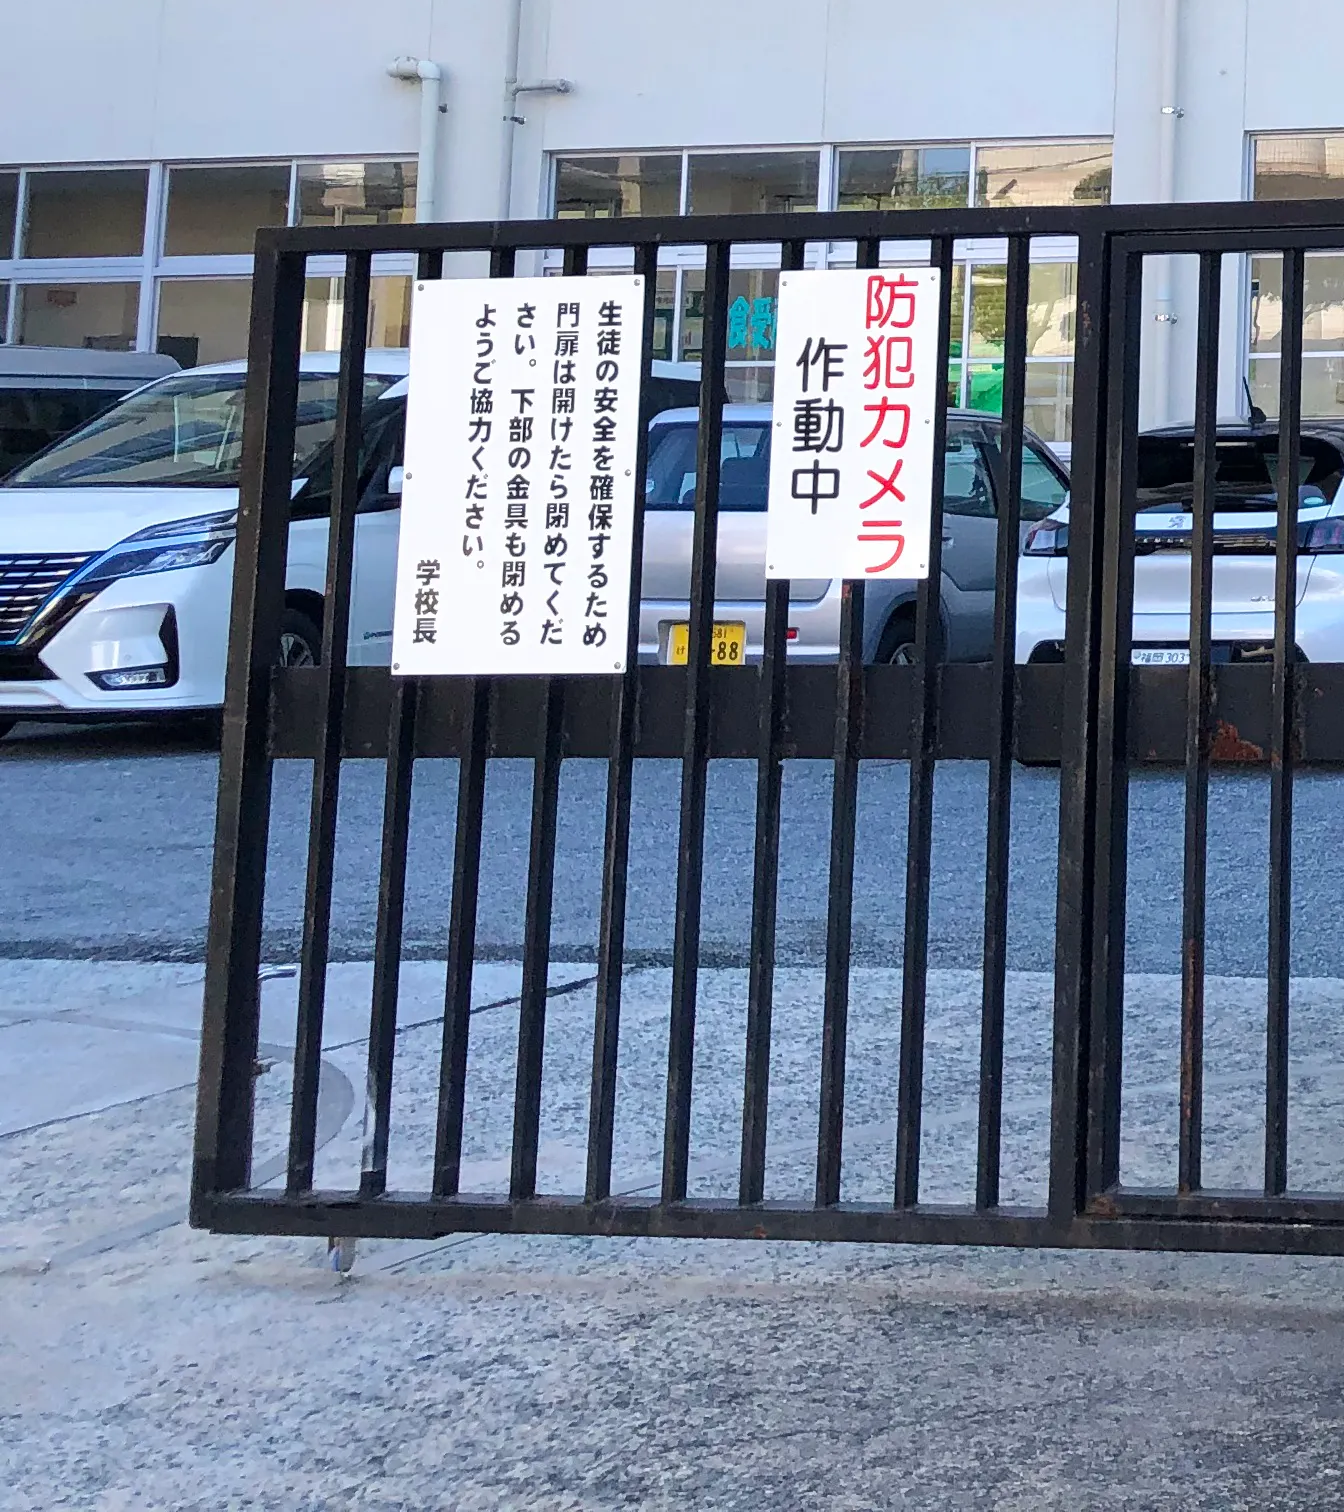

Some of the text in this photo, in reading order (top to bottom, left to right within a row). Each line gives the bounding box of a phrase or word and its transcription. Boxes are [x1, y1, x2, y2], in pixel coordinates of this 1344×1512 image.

[462, 303, 497, 569] ようご協力ください。
[540, 302, 580, 645] 門扉は開けたら閉めてくだ
[583, 300, 622, 648] 生徒の安全を確保するため
[792, 337, 848, 515] 作動中
[857, 275, 919, 573] 防犯カメラ
[412, 559, 440, 644] 学校長
